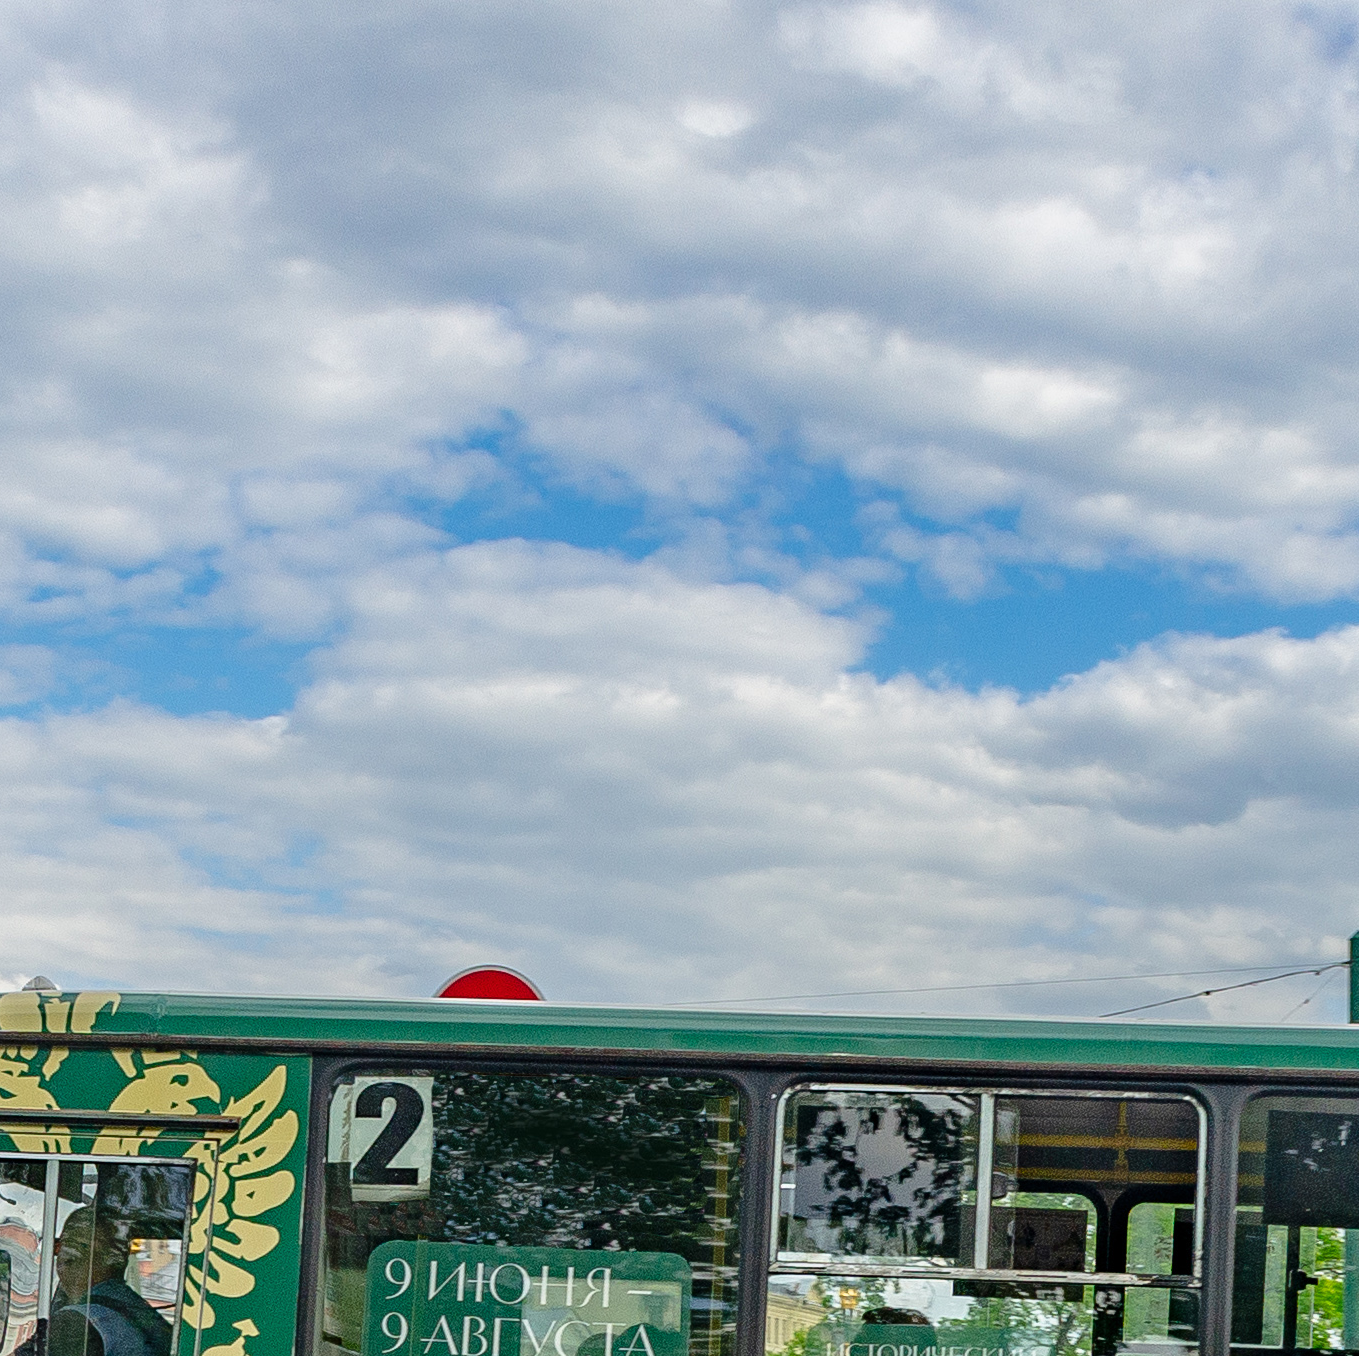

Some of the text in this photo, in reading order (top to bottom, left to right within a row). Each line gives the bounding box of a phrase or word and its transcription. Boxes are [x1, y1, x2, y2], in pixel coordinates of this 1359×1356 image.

[353, 1081, 425, 1186] 2
[385, 1257, 413, 1300] 9
[427, 1260, 613, 1309] ИЮНЯ
[381, 1311, 409, 1354] 9
